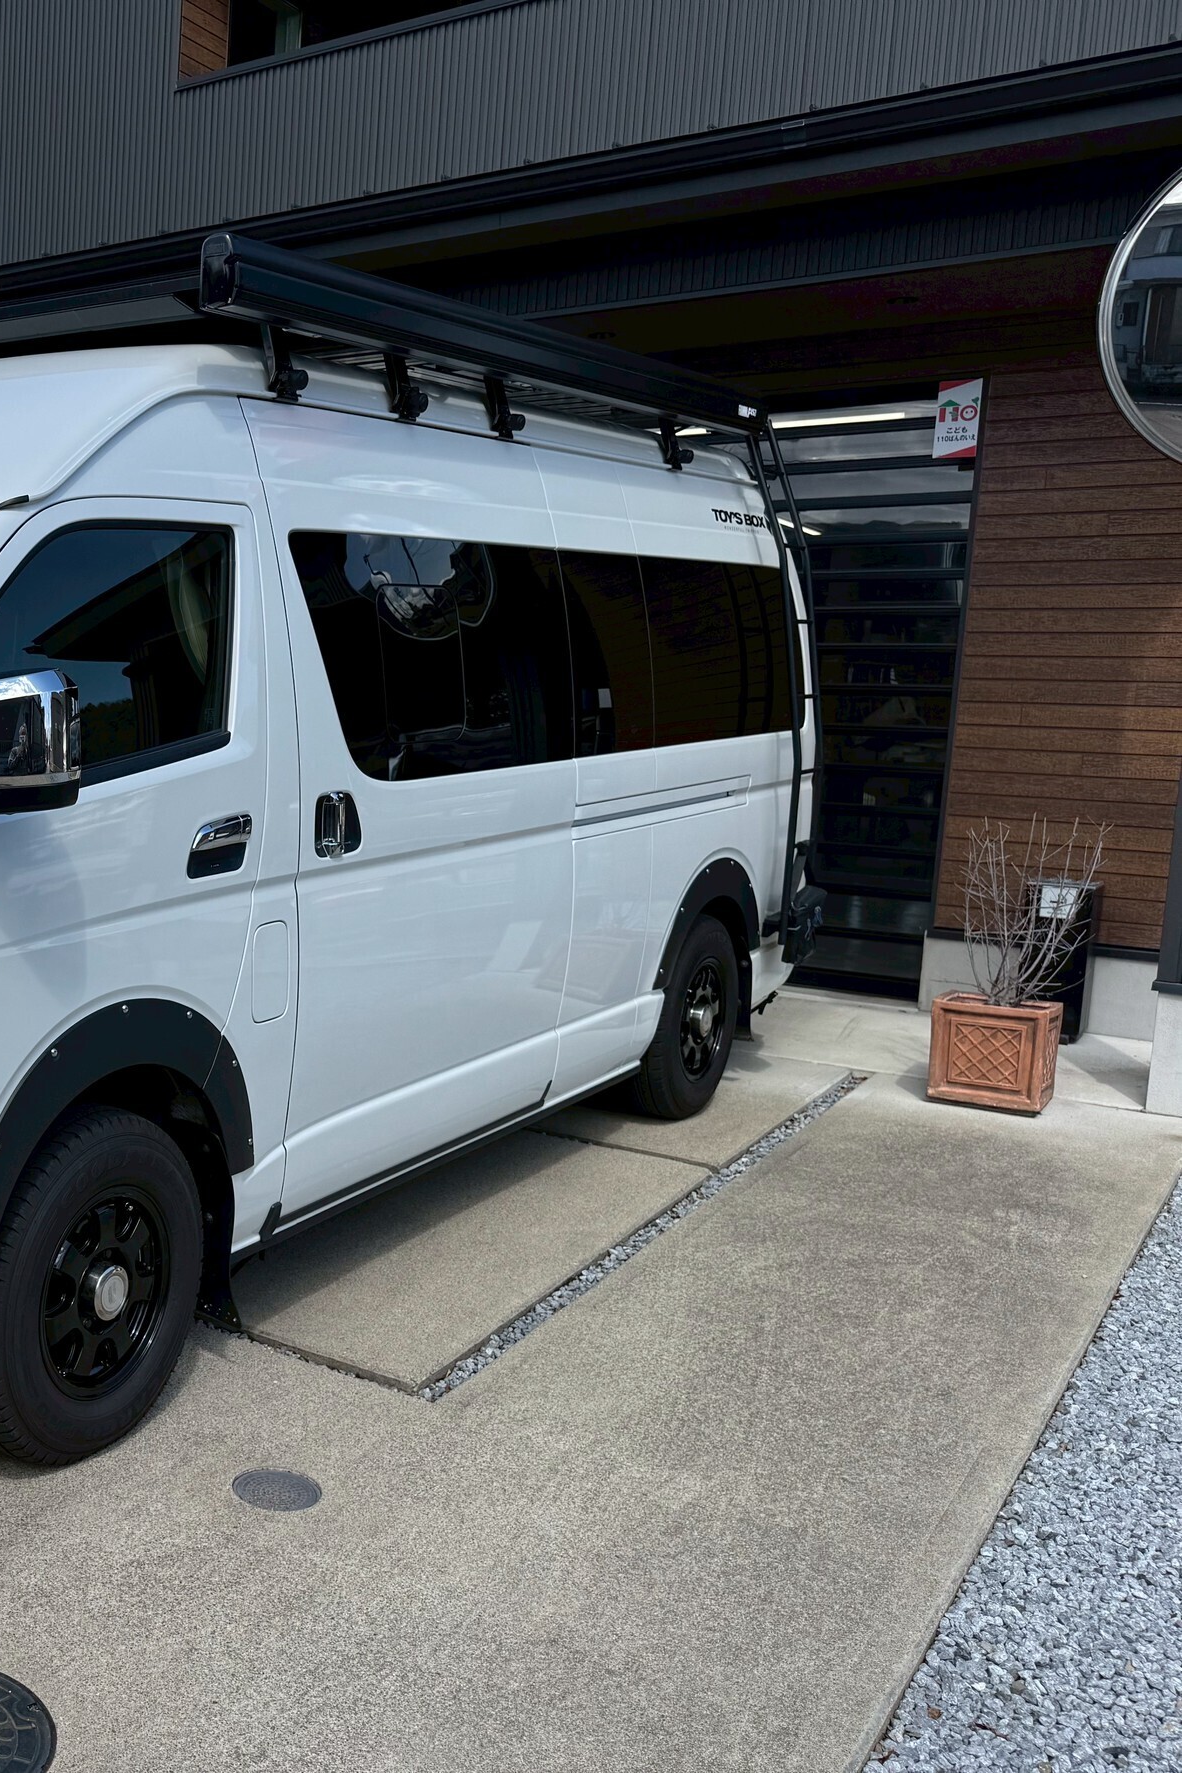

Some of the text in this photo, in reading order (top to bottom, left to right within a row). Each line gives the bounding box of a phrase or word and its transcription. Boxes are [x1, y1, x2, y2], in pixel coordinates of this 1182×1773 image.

[946, 426, 968, 434] こども
[937, 434, 976, 443] 110ばんのいえ
[711, 508, 766, 529] TOY'S BOX
